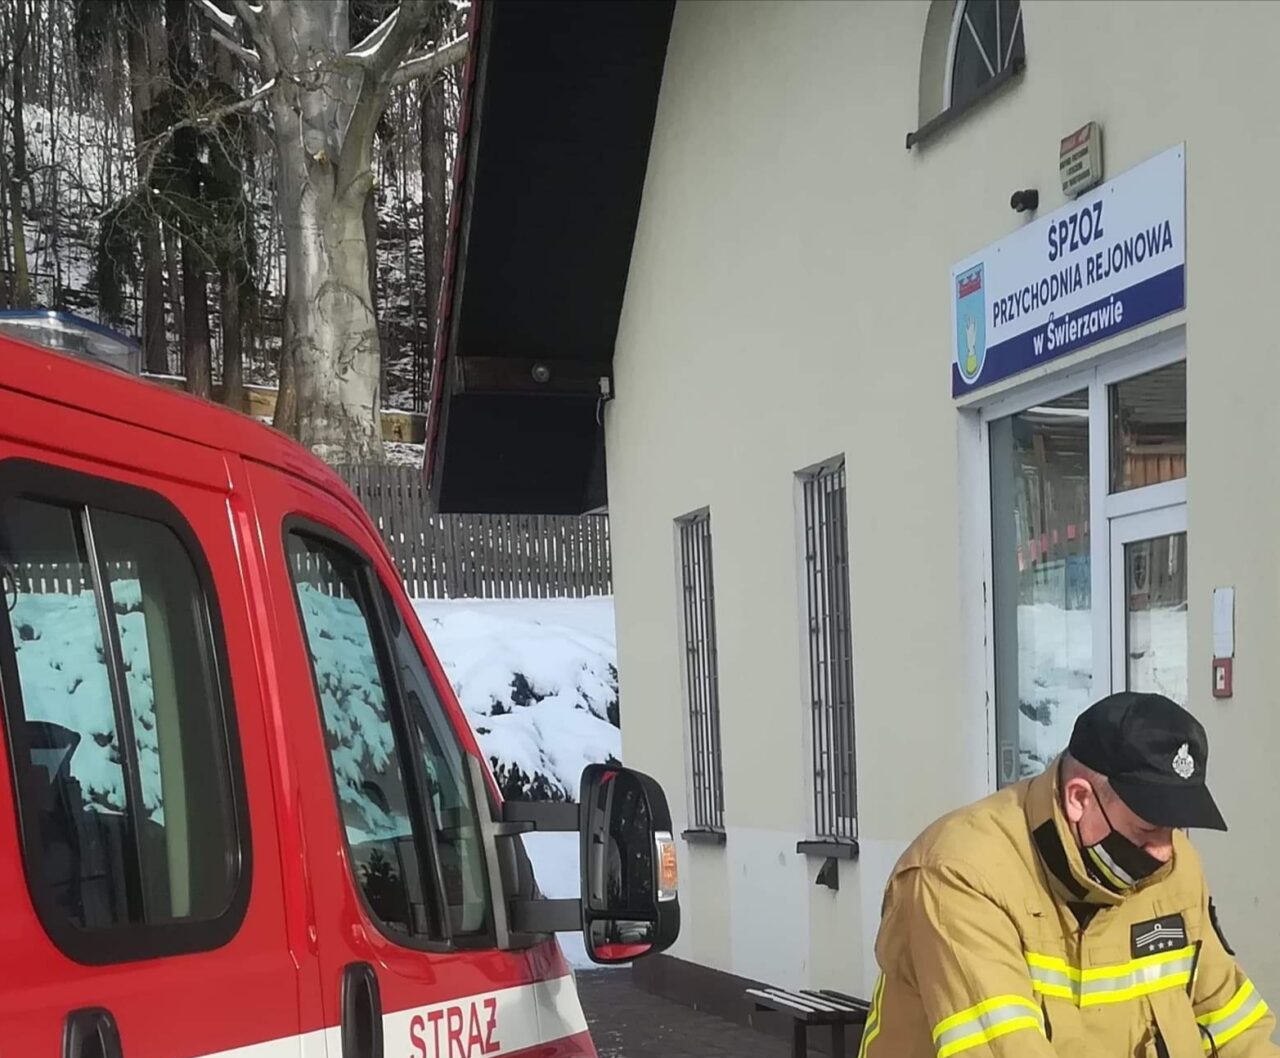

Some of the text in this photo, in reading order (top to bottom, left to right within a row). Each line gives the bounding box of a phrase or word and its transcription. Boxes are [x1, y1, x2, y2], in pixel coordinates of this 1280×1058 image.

[993, 220, 1173, 328] PRZYCHODNIA REJONOWA
[1033, 297, 1123, 356] w Świerzawie
